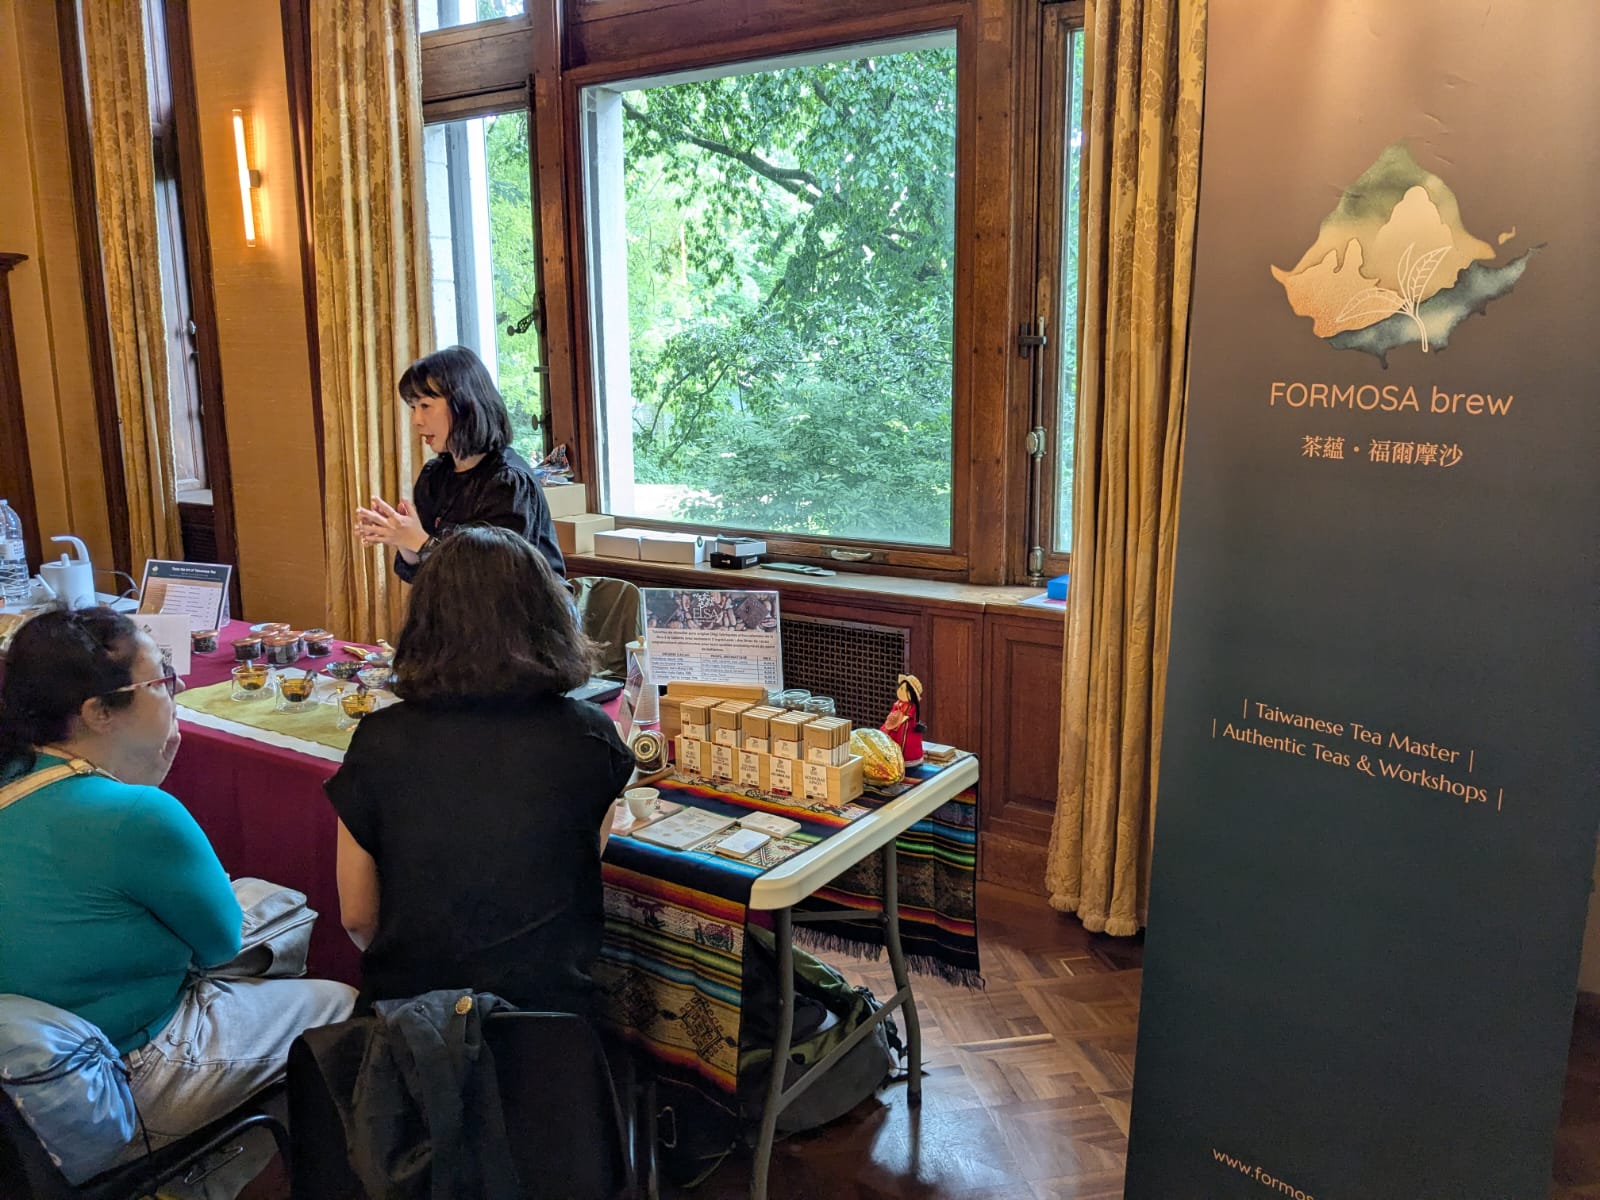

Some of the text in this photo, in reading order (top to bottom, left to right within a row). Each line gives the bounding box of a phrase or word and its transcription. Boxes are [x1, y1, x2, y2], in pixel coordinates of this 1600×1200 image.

[1269, 382, 1514, 416] FORMOSA brew
[1222, 723, 1488, 804] Authentic Teas & Workshops
[1255, 702, 1461, 764] Taiwanese Tea Master
